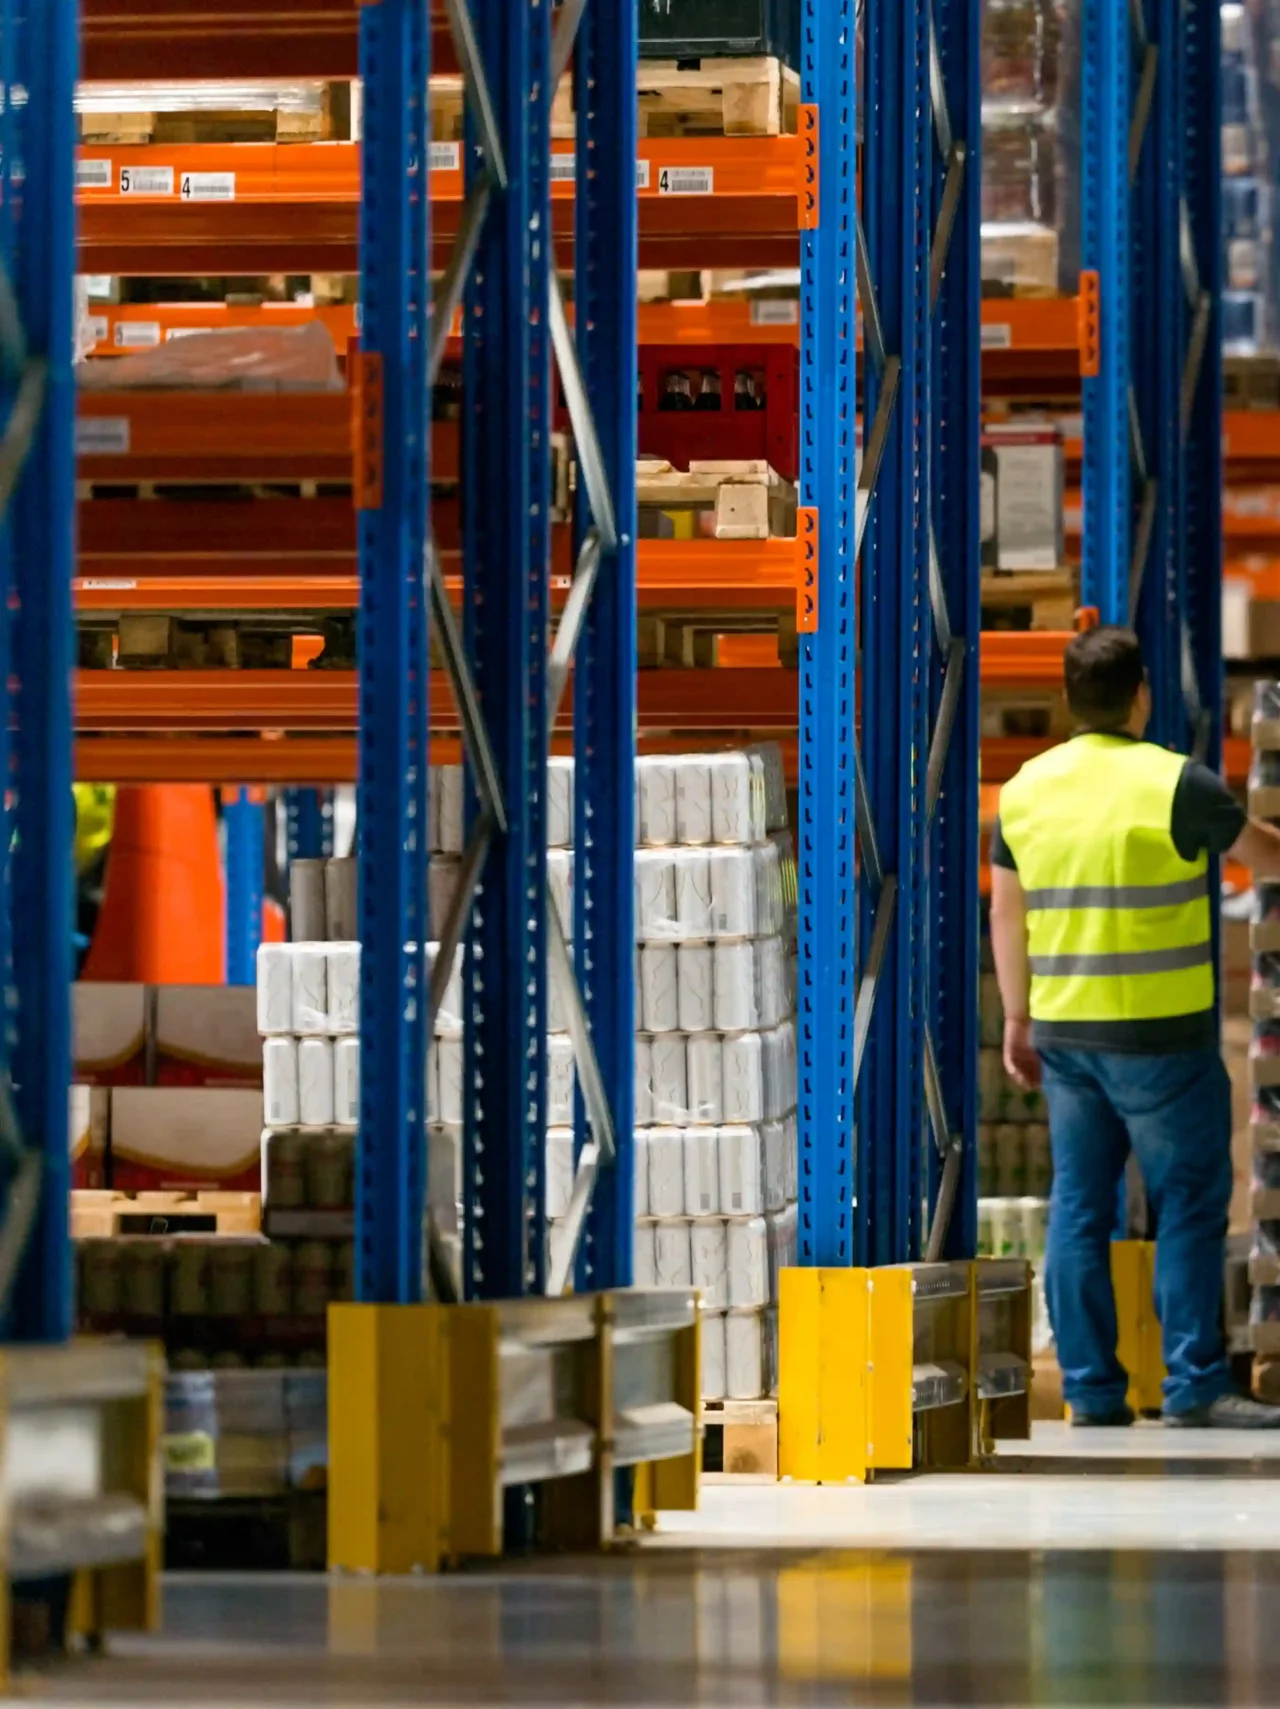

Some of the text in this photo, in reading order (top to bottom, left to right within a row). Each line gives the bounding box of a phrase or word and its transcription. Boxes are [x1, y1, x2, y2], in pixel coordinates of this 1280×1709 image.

[121, 170, 130, 191] 5
[182, 177, 191, 198] 4
[659, 170, 669, 192] 4
